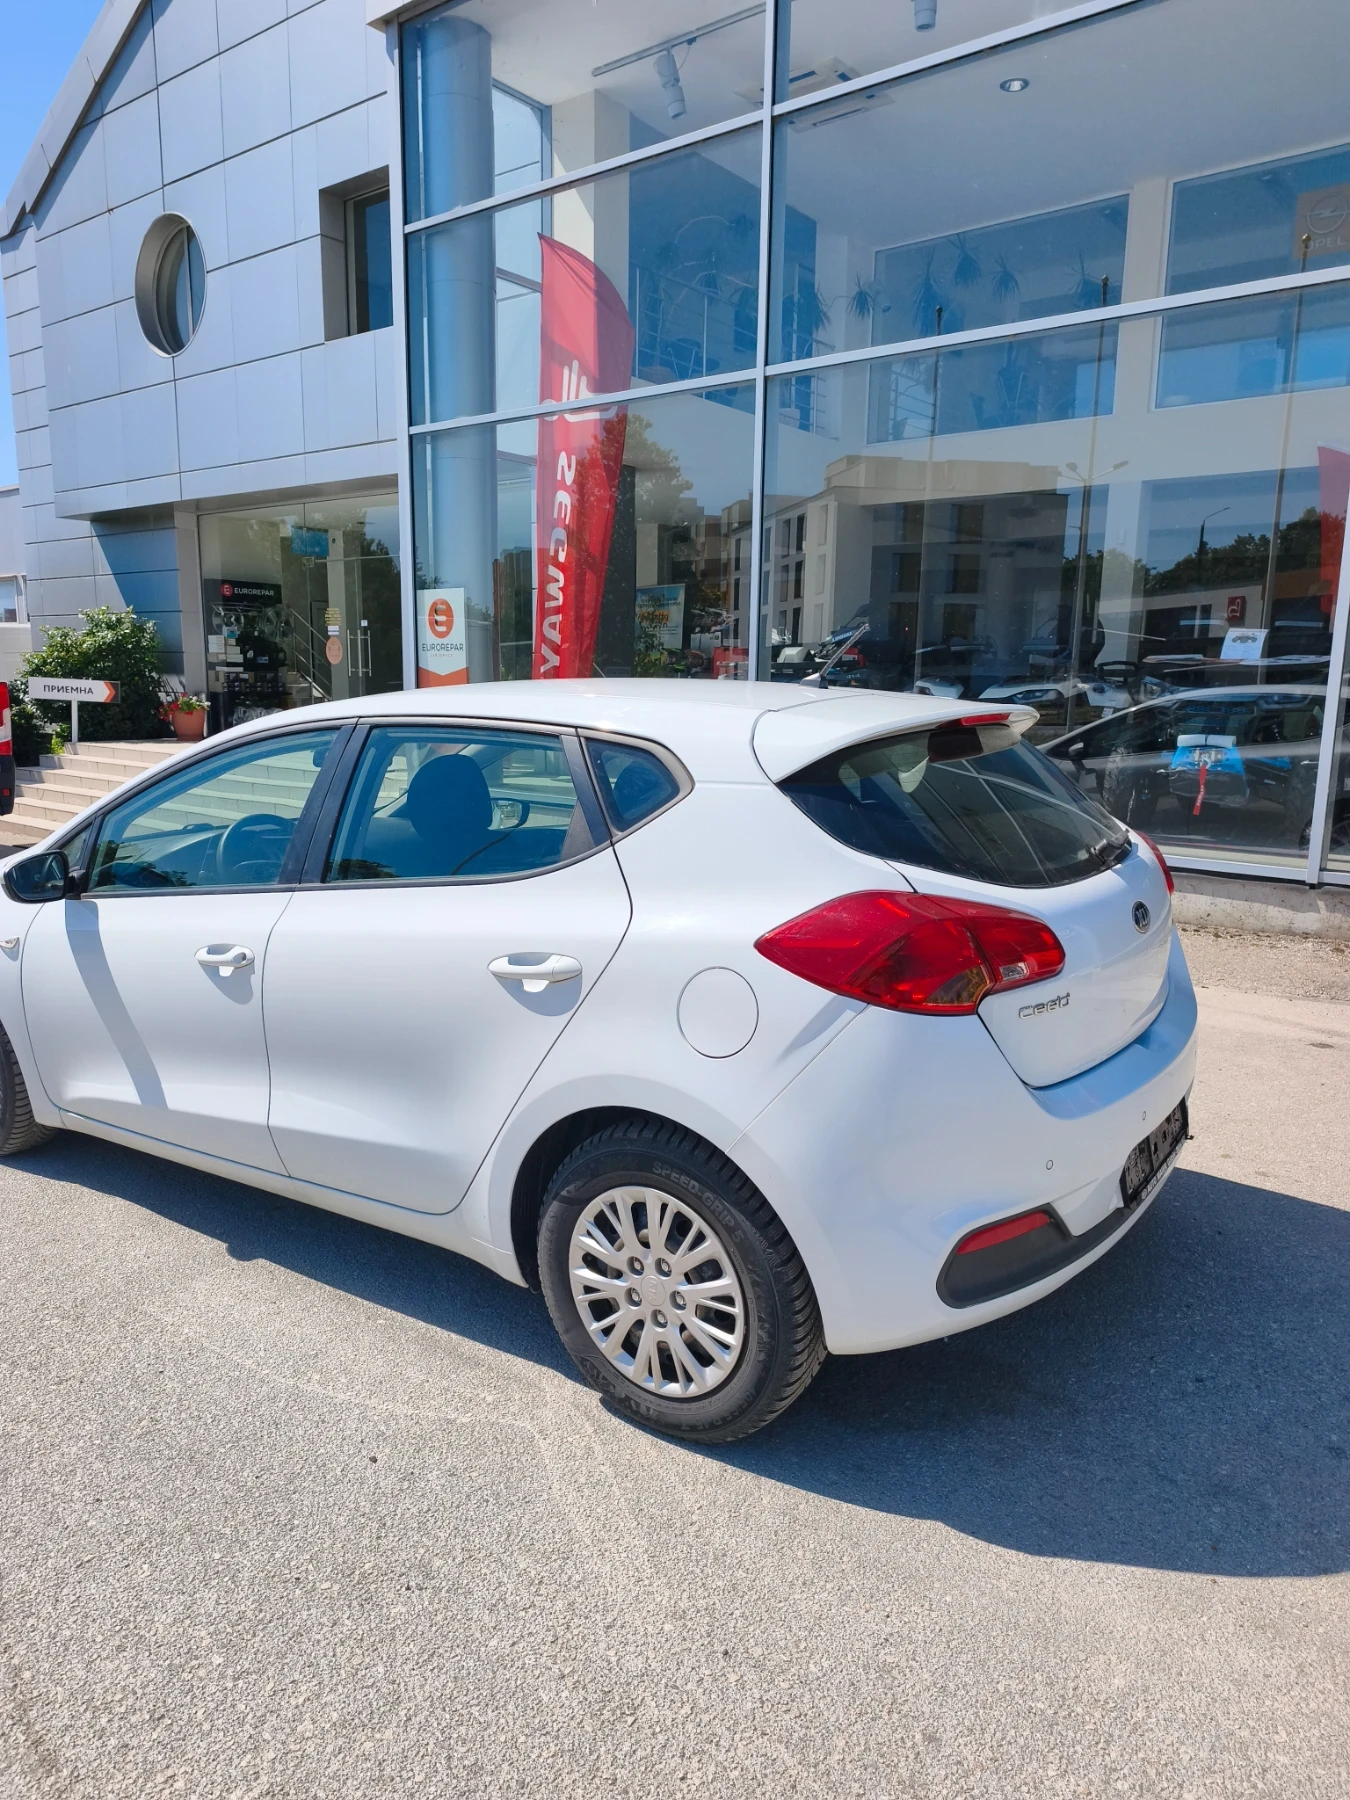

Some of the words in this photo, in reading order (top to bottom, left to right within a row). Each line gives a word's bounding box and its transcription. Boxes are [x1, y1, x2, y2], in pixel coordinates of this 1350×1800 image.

[234, 587, 274, 596] EUROREPAR
[421, 643, 464, 652] EUROREPAR
[43, 684, 94, 695] ПРИЕМНА
[652, 1161, 735, 1228] SPEED-GRIP
